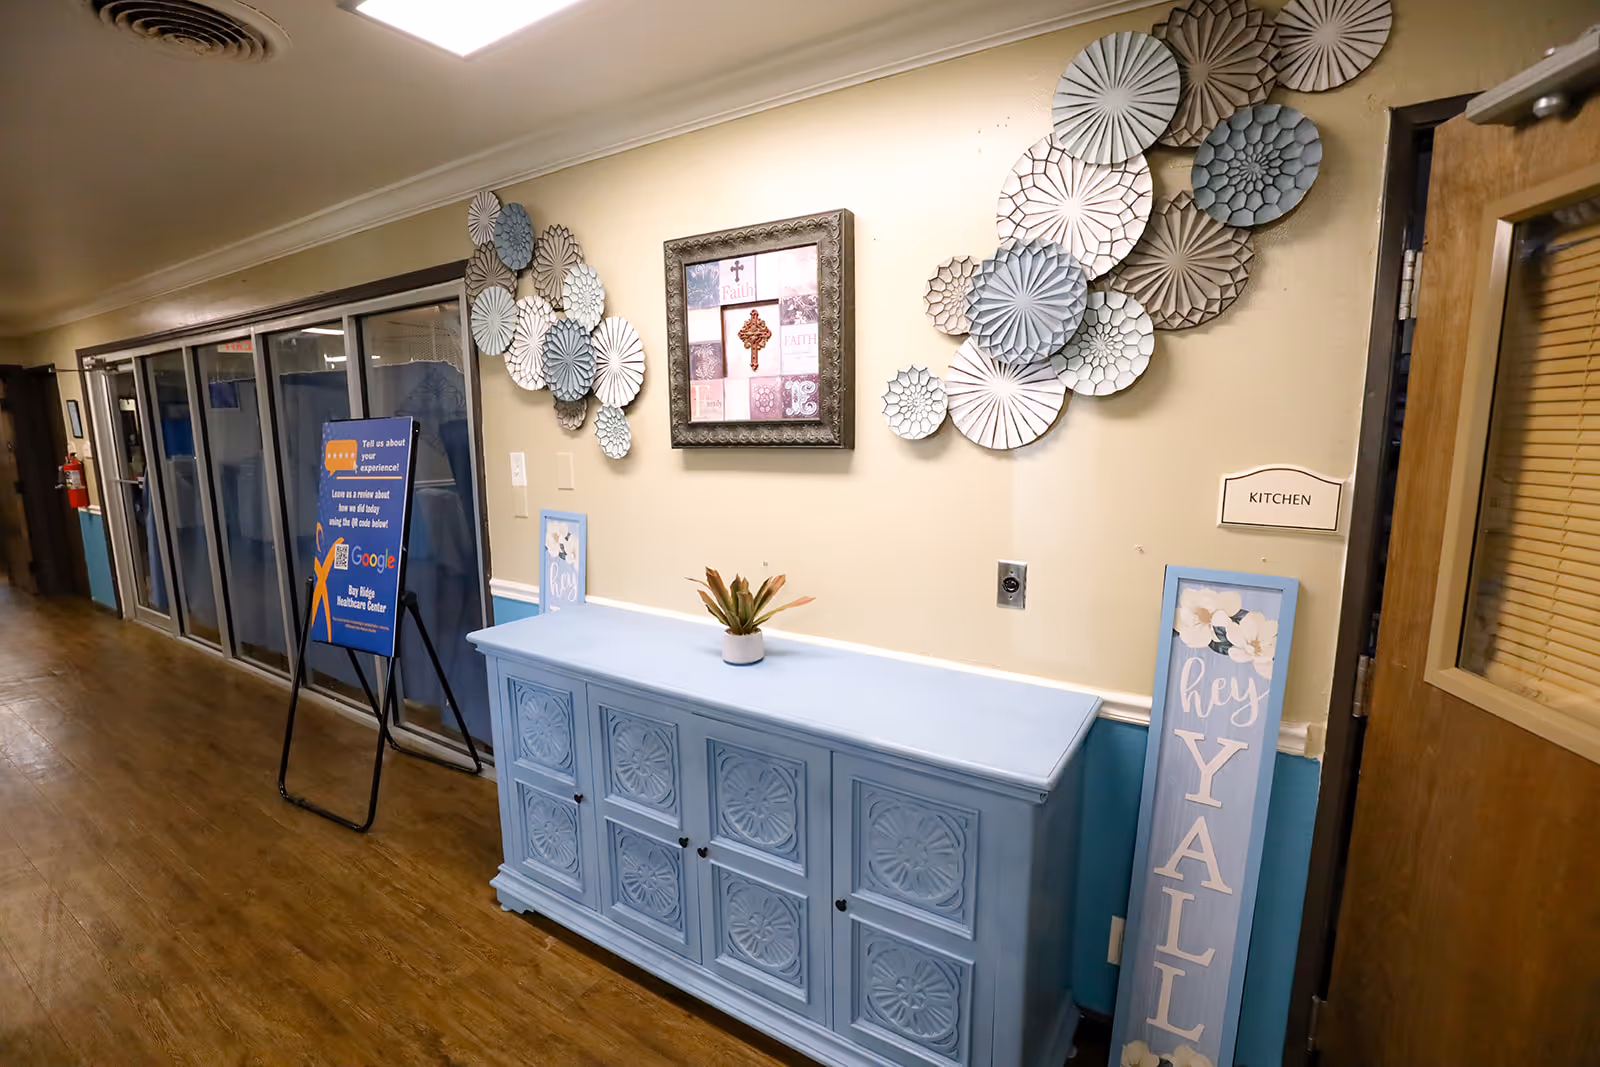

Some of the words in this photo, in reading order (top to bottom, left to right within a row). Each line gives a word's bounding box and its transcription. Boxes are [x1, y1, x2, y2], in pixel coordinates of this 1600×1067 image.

[722, 282, 754, 300] Faith
[784, 333, 817, 346] FAITH
[362, 439, 375, 448] Tell
[386, 438, 406, 447] about
[361, 453, 376, 462] your
[360, 463, 399, 473] experience!
[332, 489, 345, 499] Leave
[357, 489, 374, 499] review
[375, 489, 390, 499] about
[1249, 492, 1311, 506] KITCHEN
[338, 503, 348, 512] how
[357, 503, 365, 512] did
[366, 504, 380, 515] today
[329, 516, 342, 528] using
[342, 517, 350, 527] the
[351, 517, 358, 529] QR
[359, 518, 370, 528] code
[371, 518, 389, 529] below!
[351, 545, 395, 574] Google
[549, 561, 578, 602] hey
[348, 584, 359, 598] Bay
[360, 585, 375, 600] Ridge
[336, 595, 367, 611] Healthcare
[367, 601, 387, 613] Center
[1180, 656, 1271, 728] hey
[1146, 729, 1249, 1042] YALL
